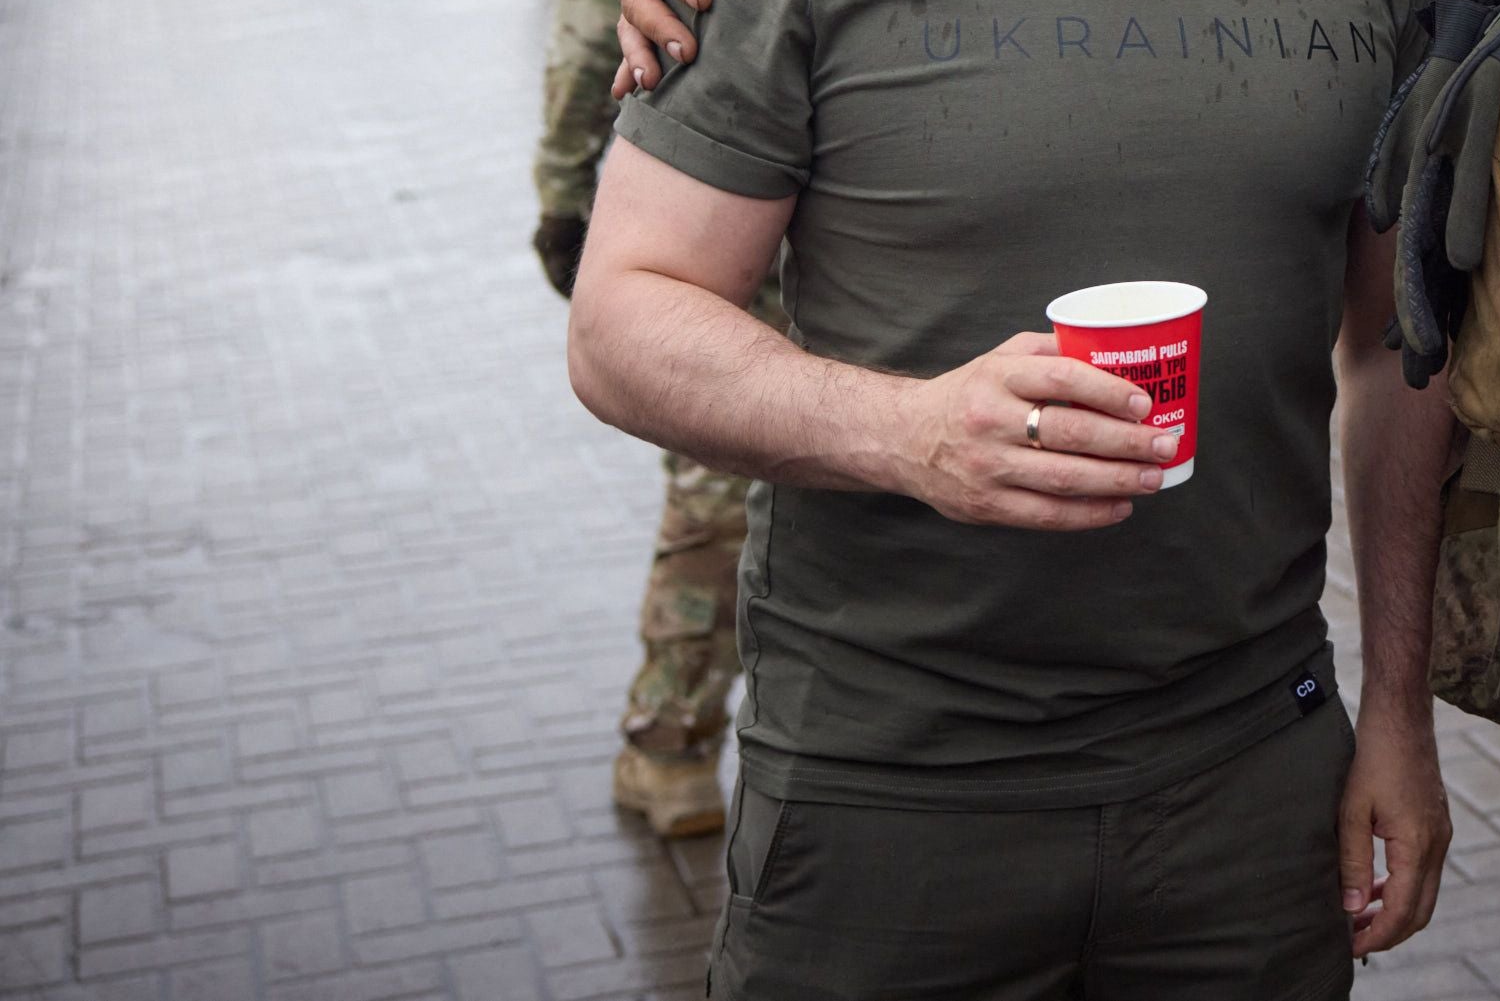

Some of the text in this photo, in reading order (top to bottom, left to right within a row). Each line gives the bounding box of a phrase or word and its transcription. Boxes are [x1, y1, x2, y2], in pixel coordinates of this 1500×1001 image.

[923, 16, 1378, 63] UKRAINIAN
[1090, 340, 1188, 365] ЗАПРАВЛЯЙ PULLS
[1166, 356, 1187, 375] ТРО
[1153, 408, 1185, 425] OKKO
[1296, 679, 1316, 697] CD
